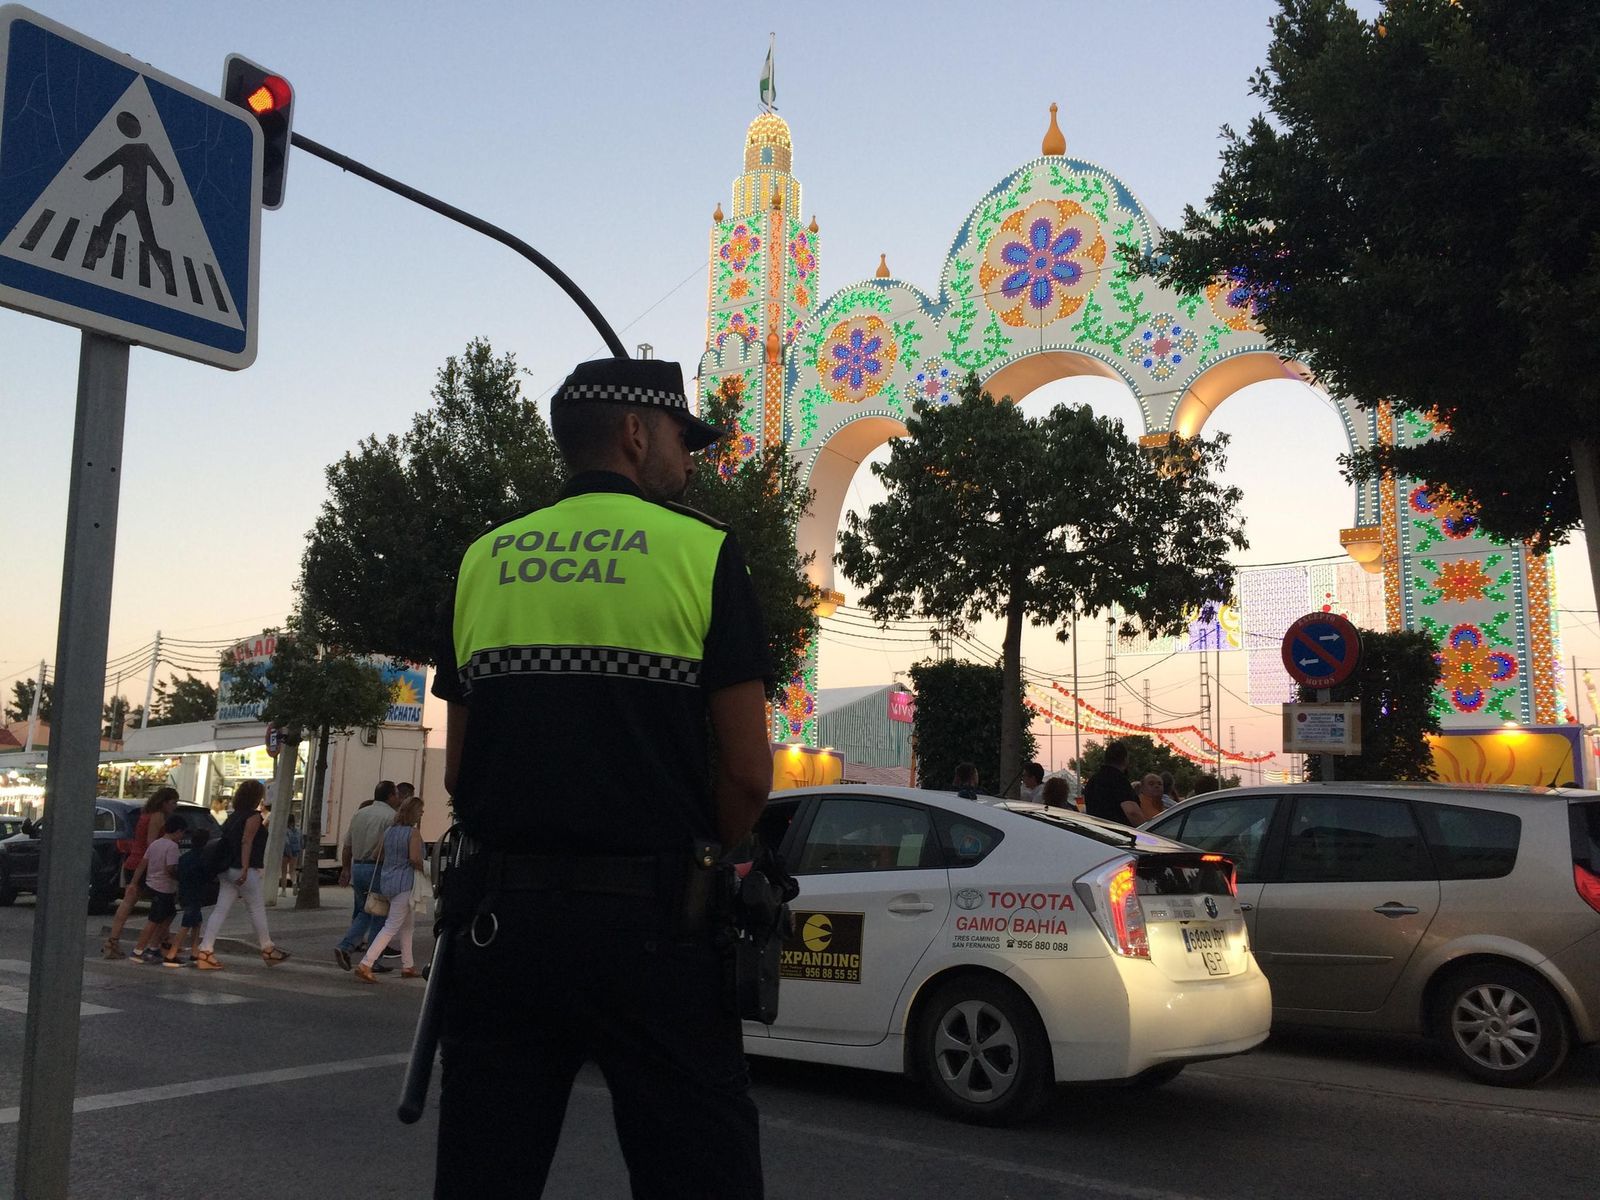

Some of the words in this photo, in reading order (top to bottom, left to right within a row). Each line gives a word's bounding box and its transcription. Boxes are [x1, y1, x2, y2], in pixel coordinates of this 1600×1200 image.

[491, 529, 649, 558] POLICIA
[499, 558, 627, 585] LOCAL
[385, 704, 421, 722] RCHATAS
[988, 891, 1075, 911] TOYOTA
[956, 916, 1008, 932] GAMO
[1012, 915, 1068, 935] BAHÍA
[1017, 940, 1033, 949] 956
[1034, 941, 1051, 950] 880
[1052, 942, 1068, 952] 088
[1206, 952, 1222, 971] SP
[805, 967, 820, 978] 956
[822, 968, 833, 979] 88
[834, 969, 845, 979] 55
[847, 970, 858, 980] 55
